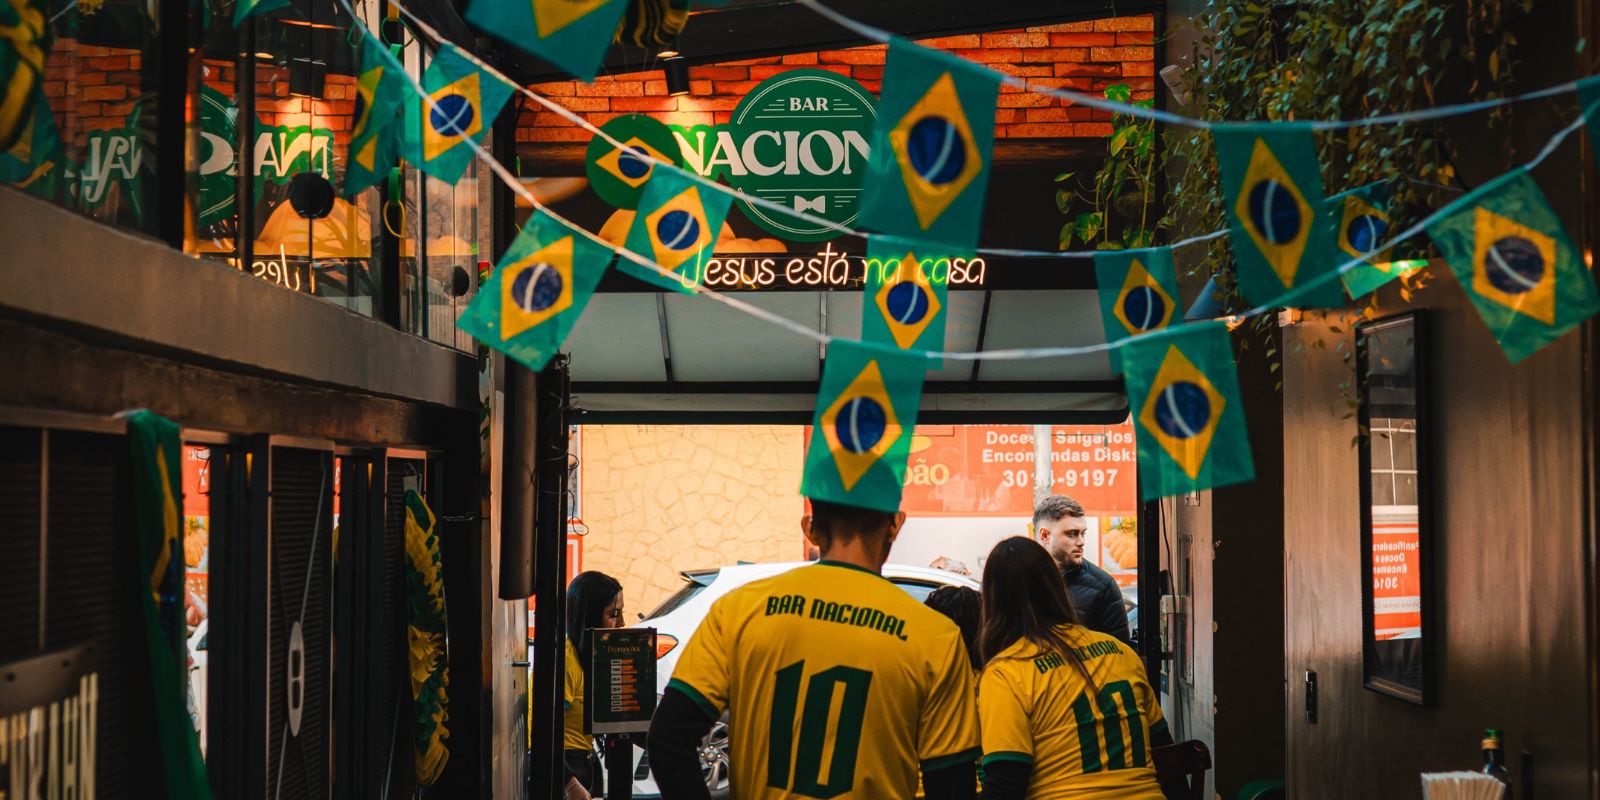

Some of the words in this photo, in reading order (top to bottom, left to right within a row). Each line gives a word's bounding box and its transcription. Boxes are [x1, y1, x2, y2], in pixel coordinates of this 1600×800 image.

[789, 97, 829, 112] BAR
[672, 129, 871, 177] NACION
[680, 242, 776, 288] Jesus
[785, 242, 850, 285] está
[861, 257, 902, 285] na
[917, 257, 986, 285] casa
[982, 448, 1091, 463] Encomndas
[1055, 430, 1133, 447] Salgados
[1002, 469, 1119, 488] 30-9197
[765, 594, 806, 616] BAR
[809, 598, 908, 641] NACIONAL
[1034, 650, 1066, 675] BAR
[766, 659, 873, 800] 10
[1072, 679, 1147, 774] 10
